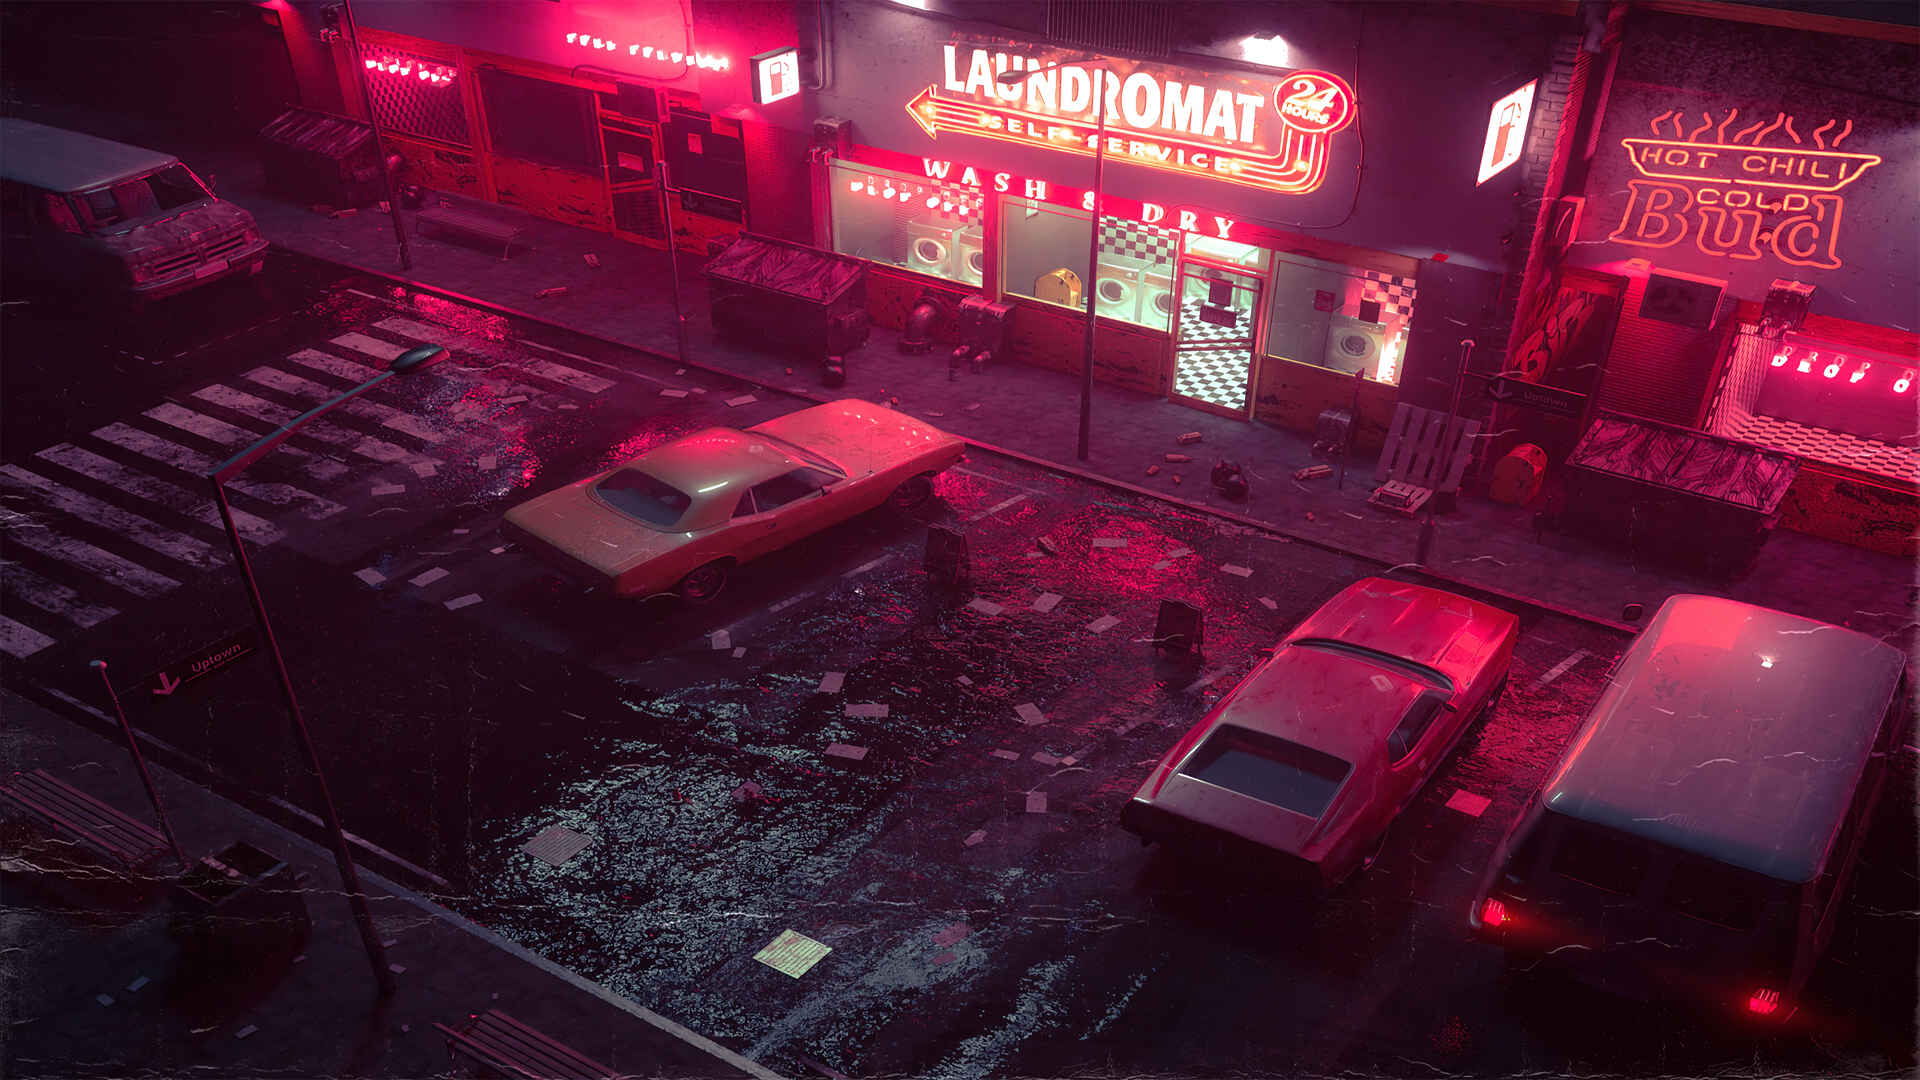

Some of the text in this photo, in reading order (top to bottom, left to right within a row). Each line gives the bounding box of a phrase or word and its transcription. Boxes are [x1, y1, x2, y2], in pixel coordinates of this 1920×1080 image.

[943, 44, 1265, 145] LAUNDROMAT
[1285, 78, 1338, 111] 24
[1281, 101, 1330, 125] HOURS
[1640, 147, 1849, 180] HOT CHILI
[922, 158, 1047, 201] WASH
[1082, 190, 1098, 211] &
[1141, 202, 1235, 239] DRY
[1696, 188, 1810, 212] COLD
[1610, 180, 1843, 270] Bud
[191, 643, 242, 673] Uptown
